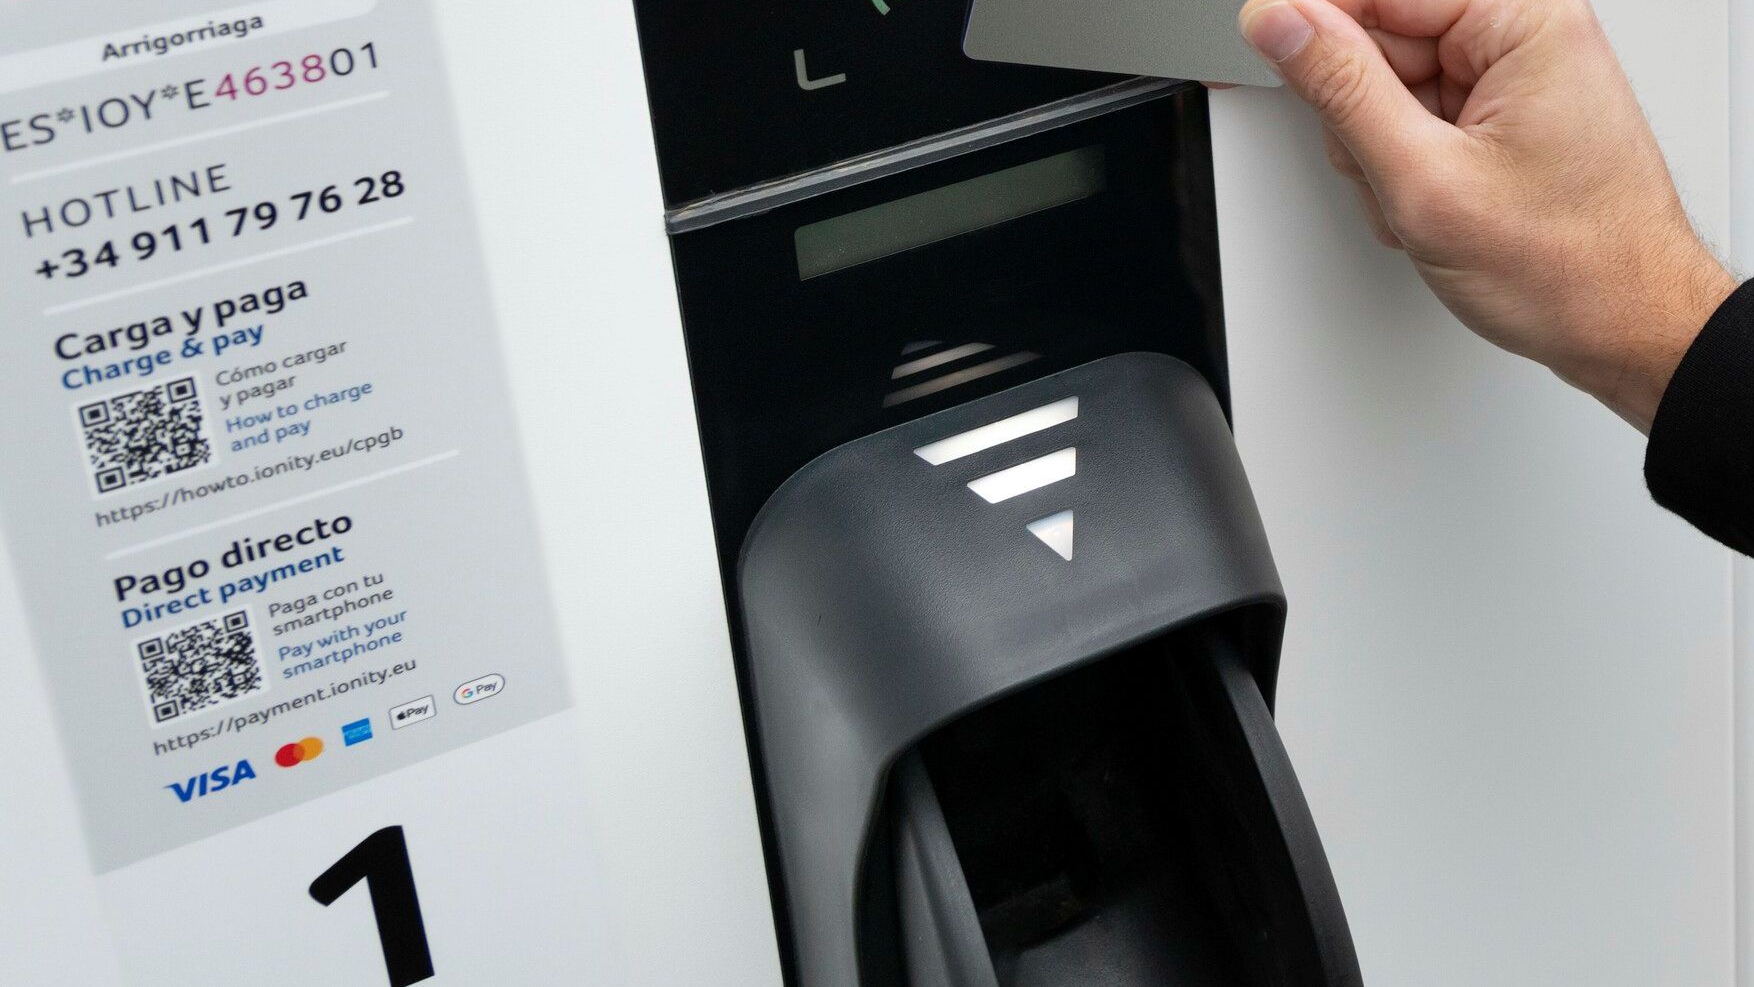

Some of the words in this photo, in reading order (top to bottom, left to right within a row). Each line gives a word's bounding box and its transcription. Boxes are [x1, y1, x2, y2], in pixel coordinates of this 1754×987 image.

[102, 15, 264, 61] Arrigorriaga
[22, 163, 232, 238] HOTLINE
[36, 241, 120, 280] +34
[132, 218, 210, 260] 911
[225, 201, 278, 237] 79
[294, 186, 342, 220] 76
[355, 170, 404, 206] 28
[54, 316, 172, 361] Carga
[183, 307, 204, 334] y
[214, 279, 309, 327] paga
[62, 349, 172, 391] Charge
[181, 337, 204, 359] &
[212, 324, 265, 356] pay
[215, 357, 277, 386] Cómo
[282, 340, 347, 370] cargar
[219, 394, 233, 411] y
[237, 375, 296, 406] pagar
[226, 409, 272, 433] How
[276, 400, 299, 420] to
[303, 379, 373, 414] charge
[230, 429, 270, 452] and
[275, 419, 312, 444] pay
[95, 425, 403, 528] https://howto.ionity.eu/cpgb
[113, 558, 210, 602] Pago
[221, 514, 353, 570] directo
[121, 587, 212, 629] Direct
[219, 545, 346, 603] payment
[268, 591, 318, 618] Paga
[323, 582, 358, 602] con
[363, 573, 385, 592] tu
[272, 587, 394, 637] smartphone
[278, 635, 313, 663] Pay
[317, 625, 361, 650] with
[365, 609, 408, 641] your
[282, 630, 404, 680] smartphone
[153, 657, 417, 756] https://payment.ionity.eu
[476, 682, 498, 694] Pay
[162, 759, 257, 803] VISA
[308, 824, 435, 987] 1
